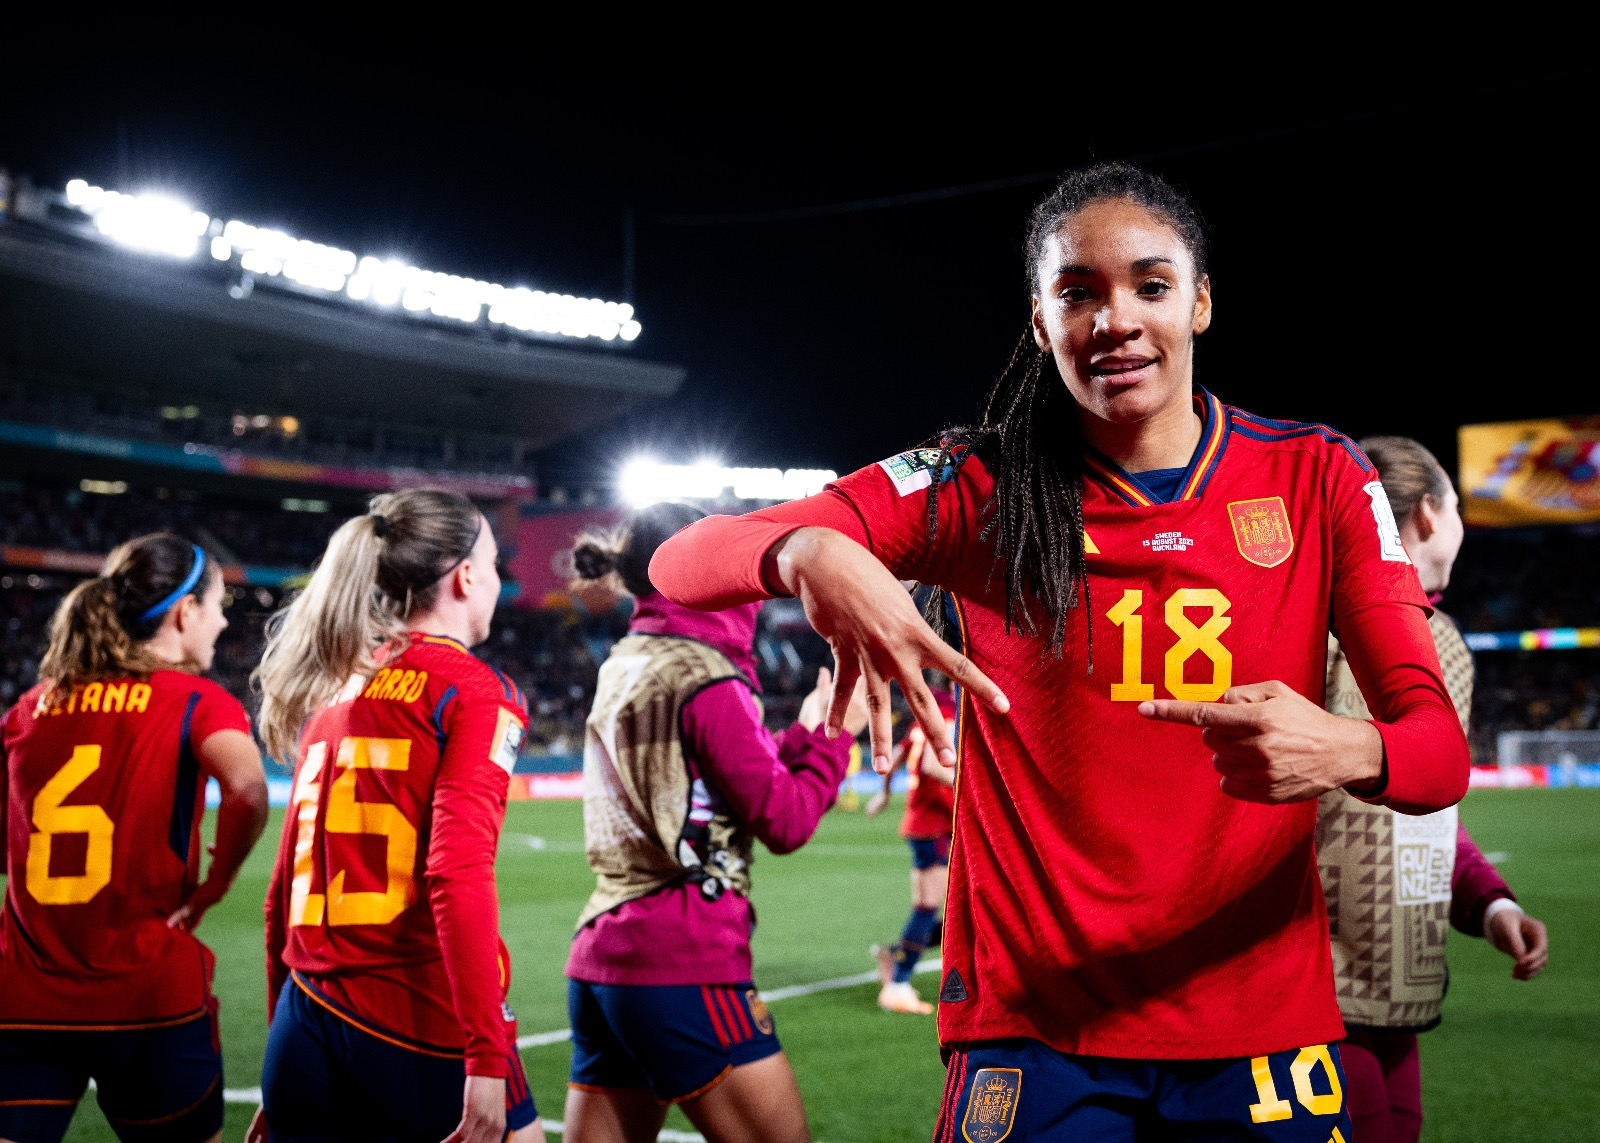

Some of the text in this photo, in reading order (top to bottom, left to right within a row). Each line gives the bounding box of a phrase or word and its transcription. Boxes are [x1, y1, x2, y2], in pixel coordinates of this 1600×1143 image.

[1151, 537, 1177, 546] AUGUST
[1178, 537, 1194, 546] 2023
[1152, 544, 1187, 552] AUCKLAND
[1155, 531, 1182, 540] SWEDEN
[1105, 588, 1233, 702] 18
[26, 744, 114, 905] 6
[288, 735, 418, 928] 15
[1400, 847, 1428, 872] AU
[1400, 873, 1427, 898] NZ
